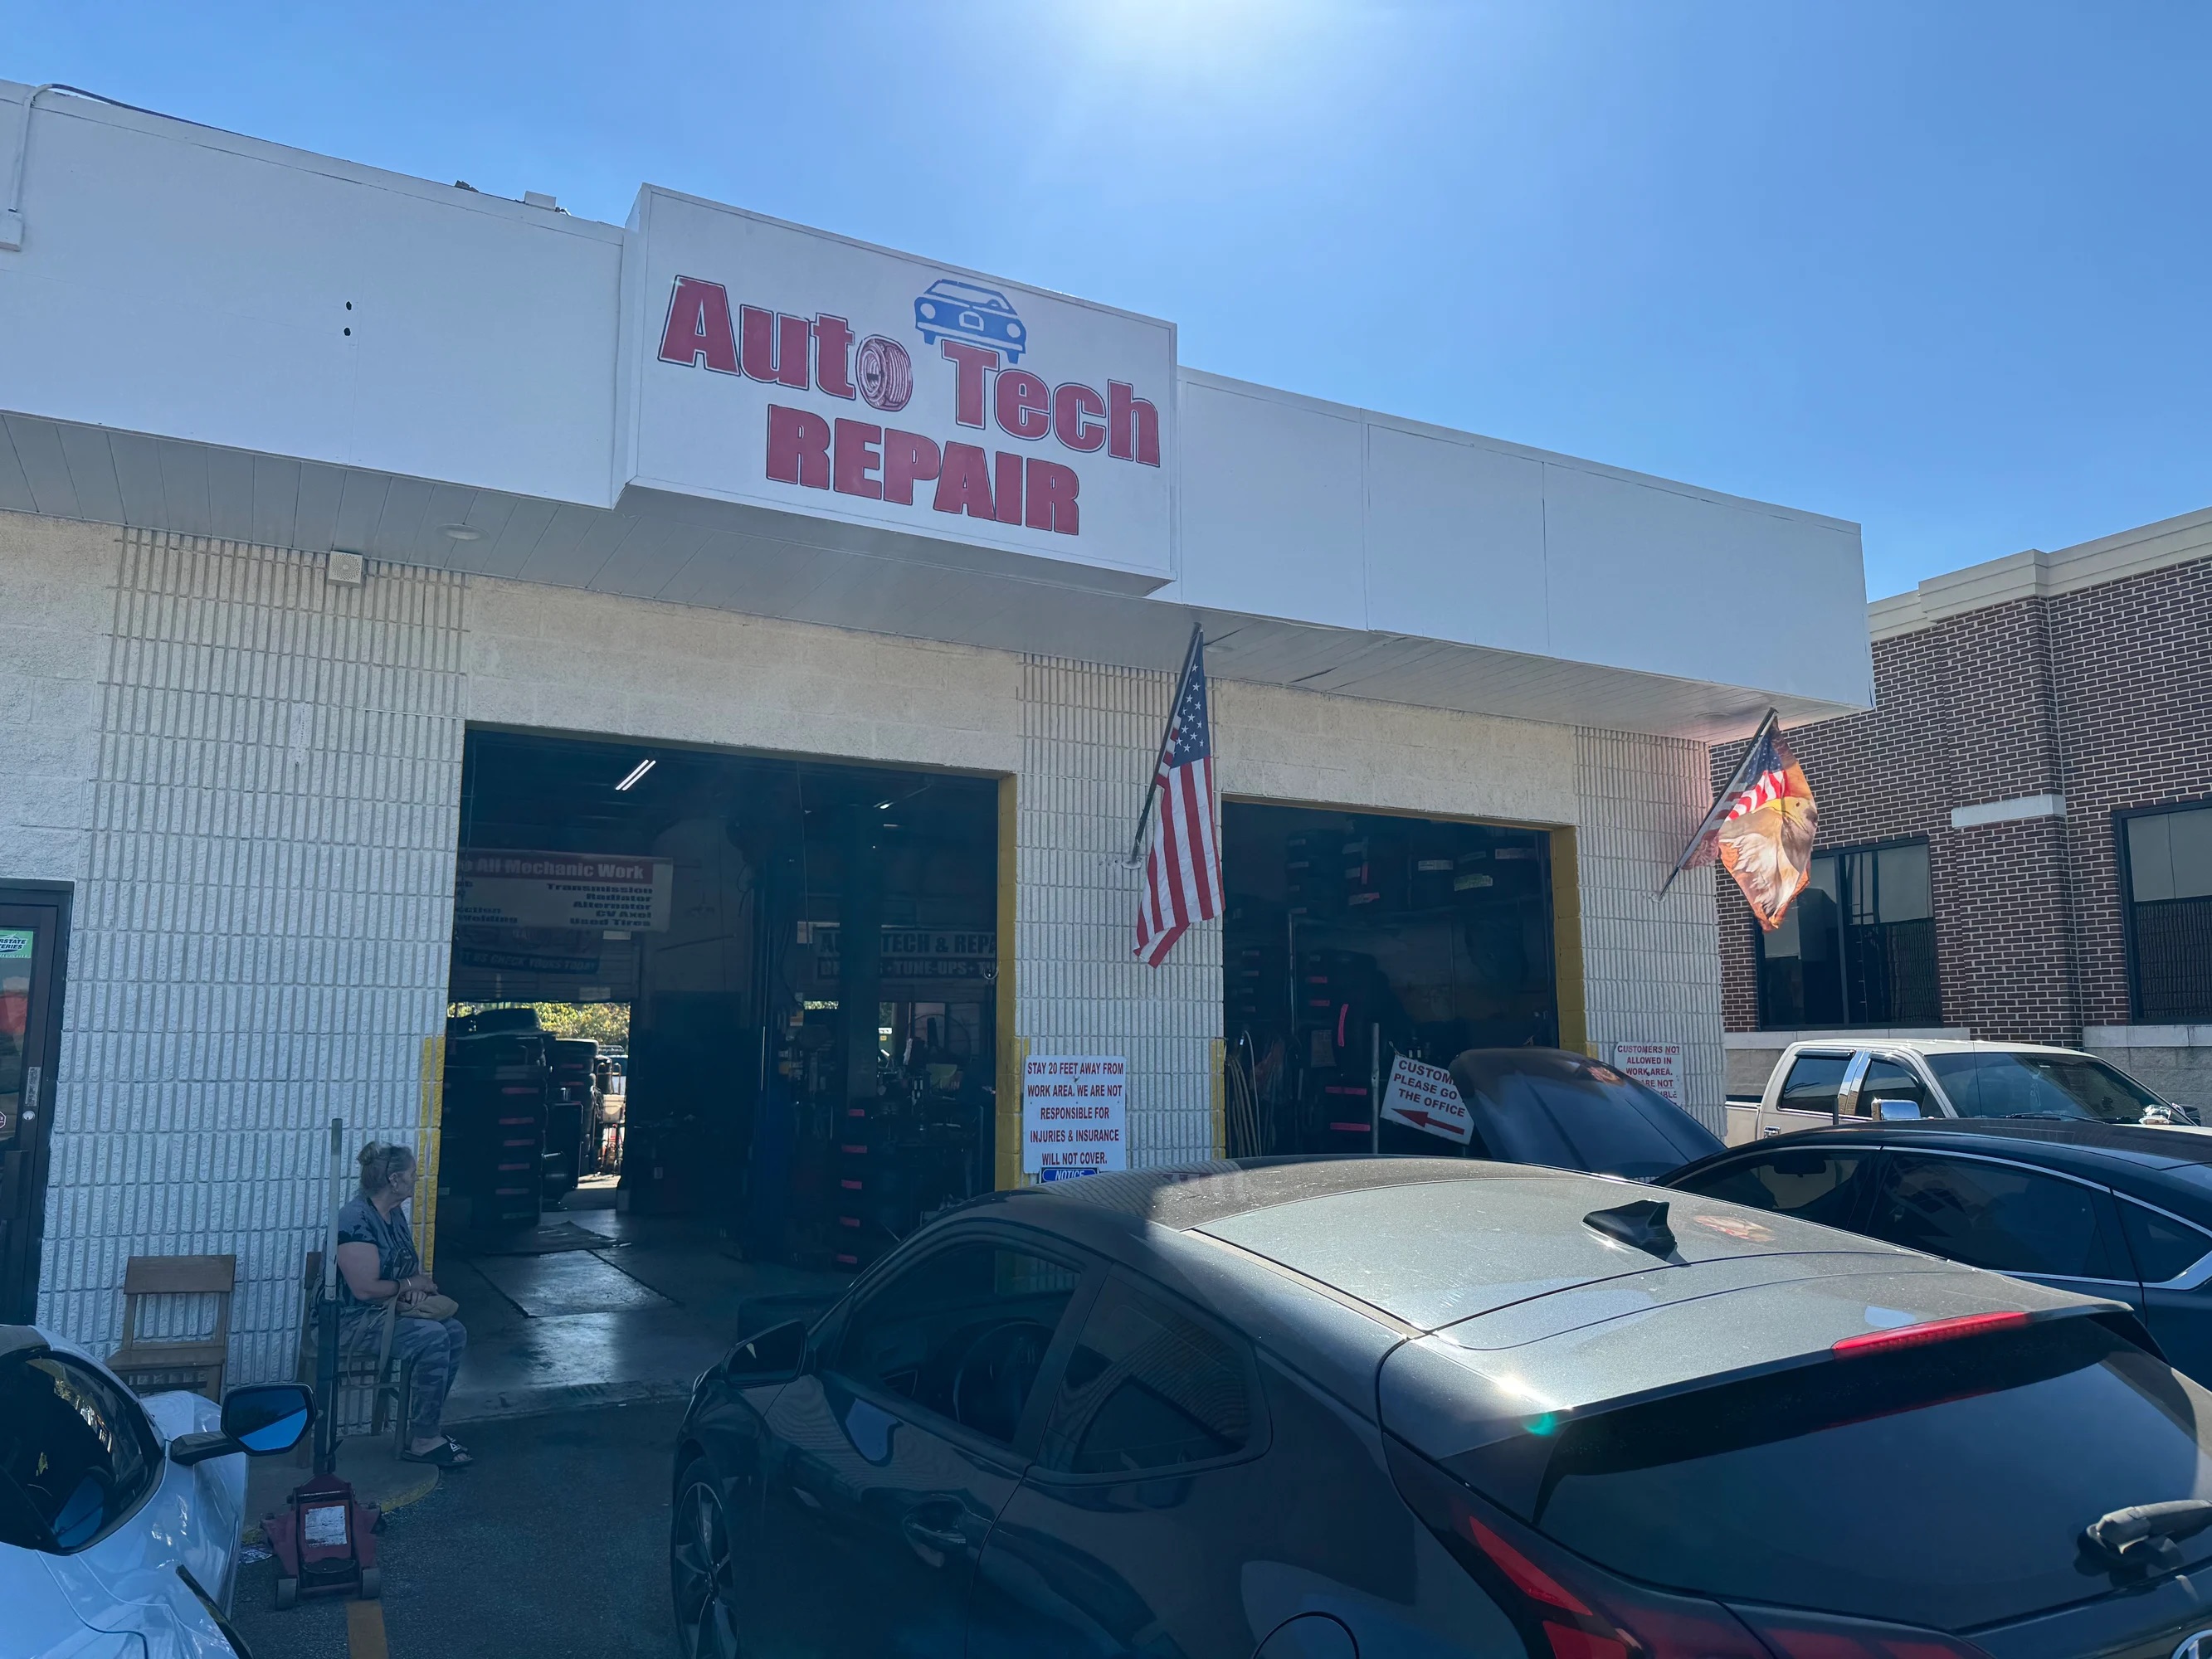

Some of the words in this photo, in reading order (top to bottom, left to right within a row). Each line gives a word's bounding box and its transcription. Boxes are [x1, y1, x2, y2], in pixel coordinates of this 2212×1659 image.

[940, 339, 1161, 468] Tech
[766, 404, 1079, 535] REPAIR
[476, 859, 500, 873] All
[504, 859, 594, 878] Mechanic
[597, 864, 644, 879] Work
[547, 883, 653, 894] Transmission
[586, 893, 652, 902] Radiator
[573, 901, 651, 911] Alternator
[881, 934, 930, 953] TECH
[935, 937, 948, 953] &
[490, 955, 525, 967] CHECK
[529, 958, 562, 970] YOURS
[564, 961, 597, 971] TODAY
[894, 960, 967, 975] TUNE-UPS
[1617, 1045, 1663, 1053] CUSTOMERS
[1027, 1063, 1046, 1074] STAY
[1049, 1063, 1058, 1074] 20
[1060, 1063, 1079, 1074] FEET
[1079, 1063, 1101, 1074] AWAY
[1103, 1063, 1123, 1074] FROM
[1398, 1060, 1454, 1085] CUSTOM
[1650, 1068, 1673, 1076] AREA.
[1027, 1085, 1050, 1097] WORK
[1053, 1085, 1075, 1097] AREA.
[1077, 1085, 1089, 1097] WE
[1090, 1085, 1105, 1097] ARE
[1107, 1085, 1123, 1097] NOT
[1394, 1073, 1437, 1094] PLEASE
[1440, 1088, 1458, 1100] GO
[1398, 1088, 1421, 1103] THE
[1424, 1097, 1465, 1118] OFFICE
[1040, 1107, 1093, 1120] RESPONSIBLE
[1094, 1107, 1109, 1119] FOR
[1030, 1130, 1065, 1143] INJURIES
[1068, 1130, 1074, 1141] &
[1075, 1129, 1119, 1142] INSURANCE
[1042, 1152, 1060, 1165] WILL
[1062, 1152, 1079, 1165] NOT
[1079, 1151, 1108, 1164] COVER.
